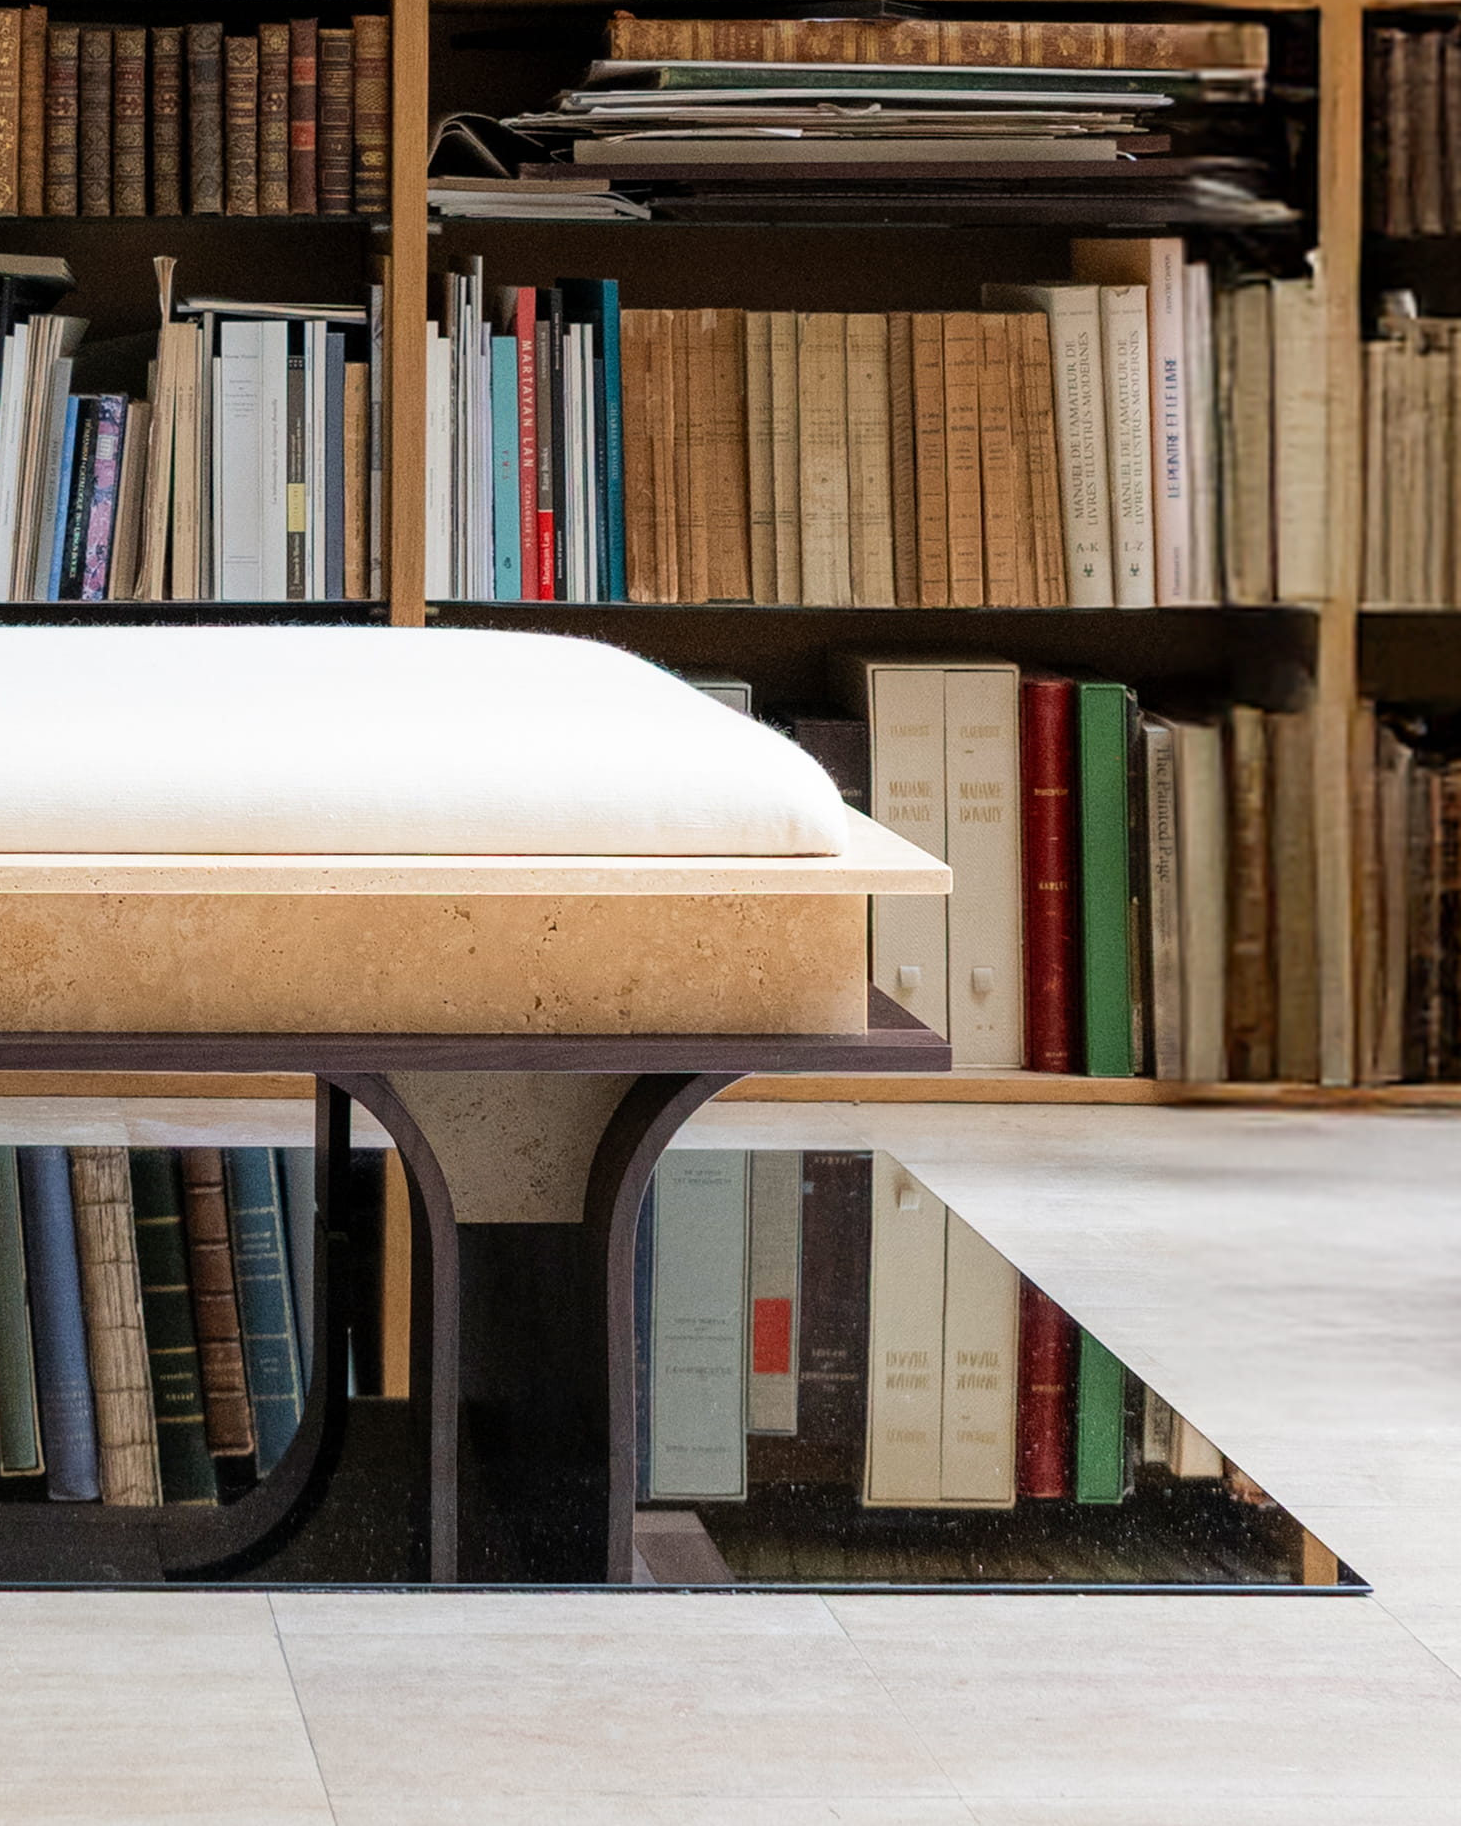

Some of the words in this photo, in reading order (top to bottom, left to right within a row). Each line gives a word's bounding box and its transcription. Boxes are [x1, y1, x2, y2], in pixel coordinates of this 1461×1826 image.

[522, 340, 534, 428] MARTAYAN
[1078, 331, 1093, 407] MODERNES
[1129, 329, 1142, 406] MODERNES
[1163, 357, 1177, 390] LIVRE
[1065, 362, 1081, 437] L'AMATEUR
[1117, 361, 1130, 436] L'AMATEUR
[523, 437, 535, 468] LAN
[1165, 432, 1179, 482] PEINTRE
[1071, 464, 1085, 519] MANUEL
[1086, 481, 1099, 526] LIVRES
[1120, 464, 1132, 518] MANUEL
[1134, 481, 1145, 525] LIVRES
[1155, 746, 1173, 778] The
[888, 781, 932, 798] MADAME
[959, 781, 1002, 800] MADAME
[1157, 781, 1173, 842] Painted
[888, 805, 932, 823] BOVARY
[959, 806, 1002, 824] BOVARY
[1157, 845, 1173, 884] Page
